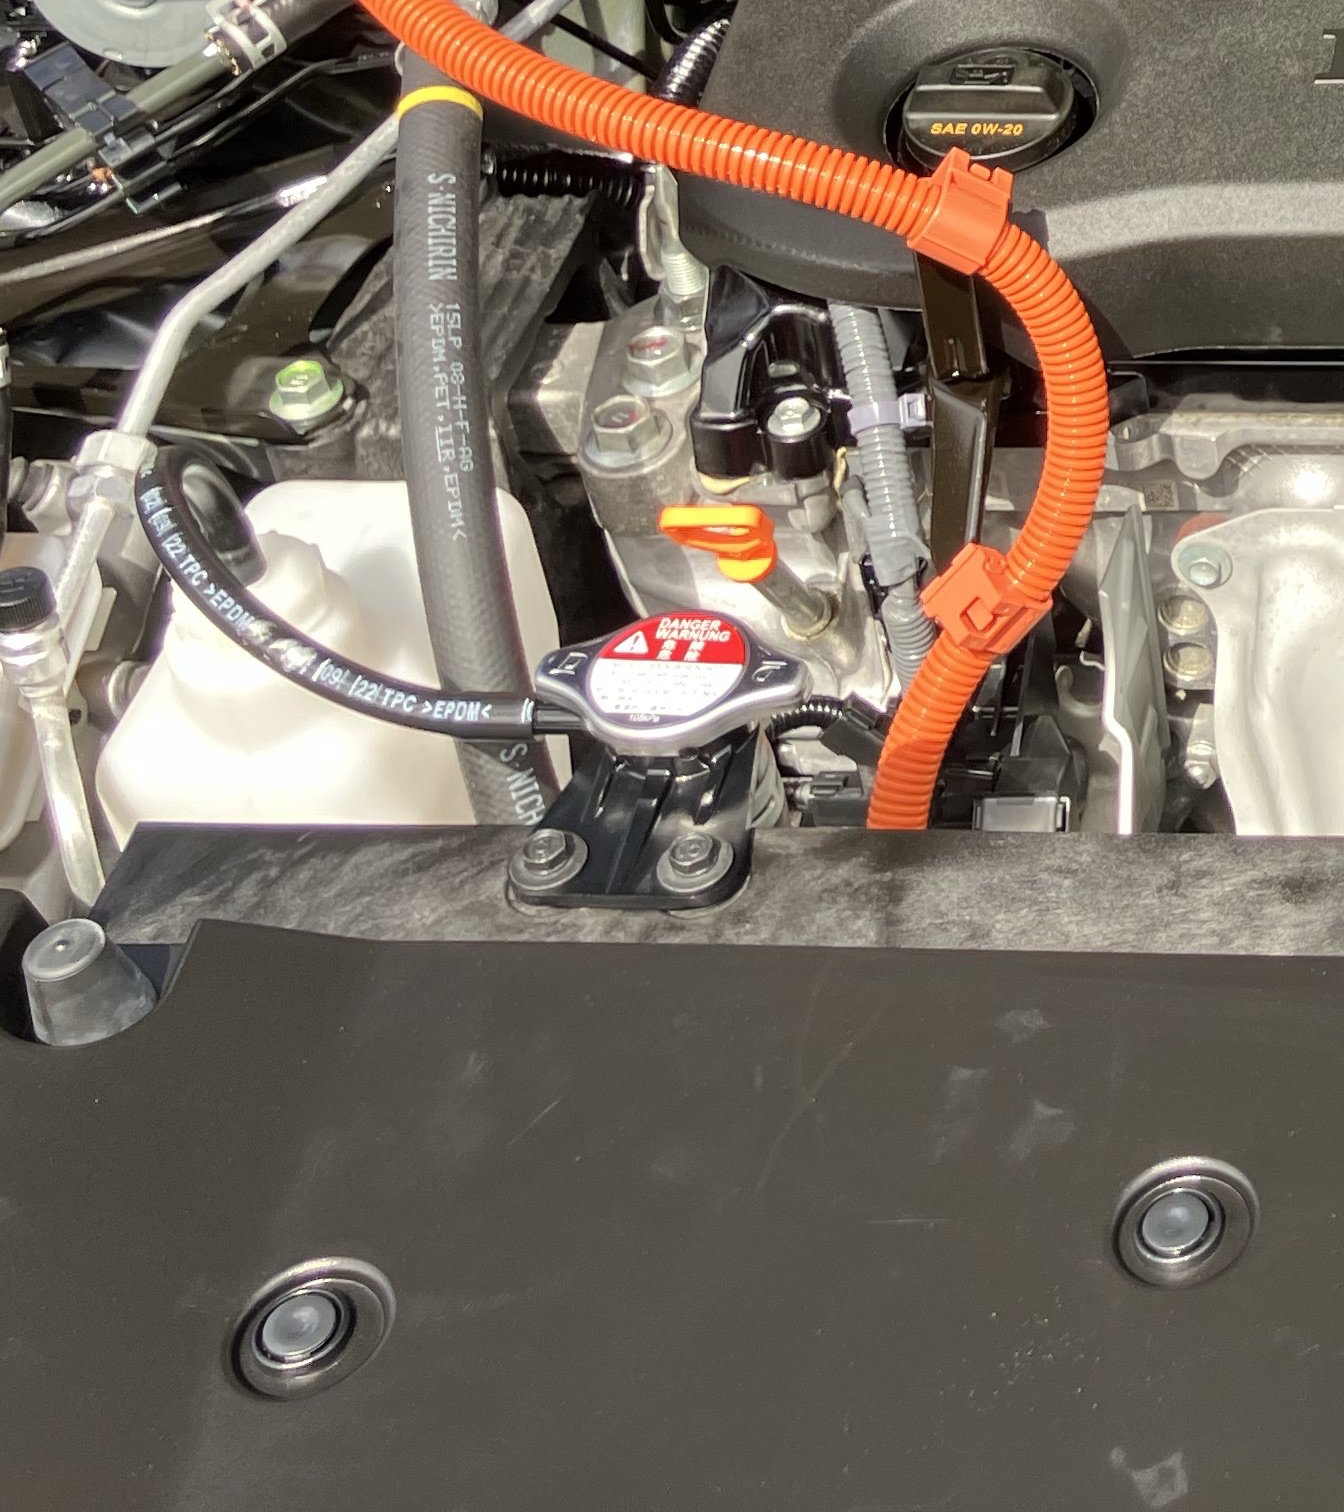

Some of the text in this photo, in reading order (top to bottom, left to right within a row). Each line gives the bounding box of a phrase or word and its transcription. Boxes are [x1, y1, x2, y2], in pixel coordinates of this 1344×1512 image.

[930, 122, 1024, 136] SAE 0W-20
[179, 554, 209, 586] TPC
[658, 617, 721, 631] DANGER
[655, 627, 732, 642] WARNUNG
[381, 688, 418, 713] TPC
[420, 700, 493, 722] >EPDM<
